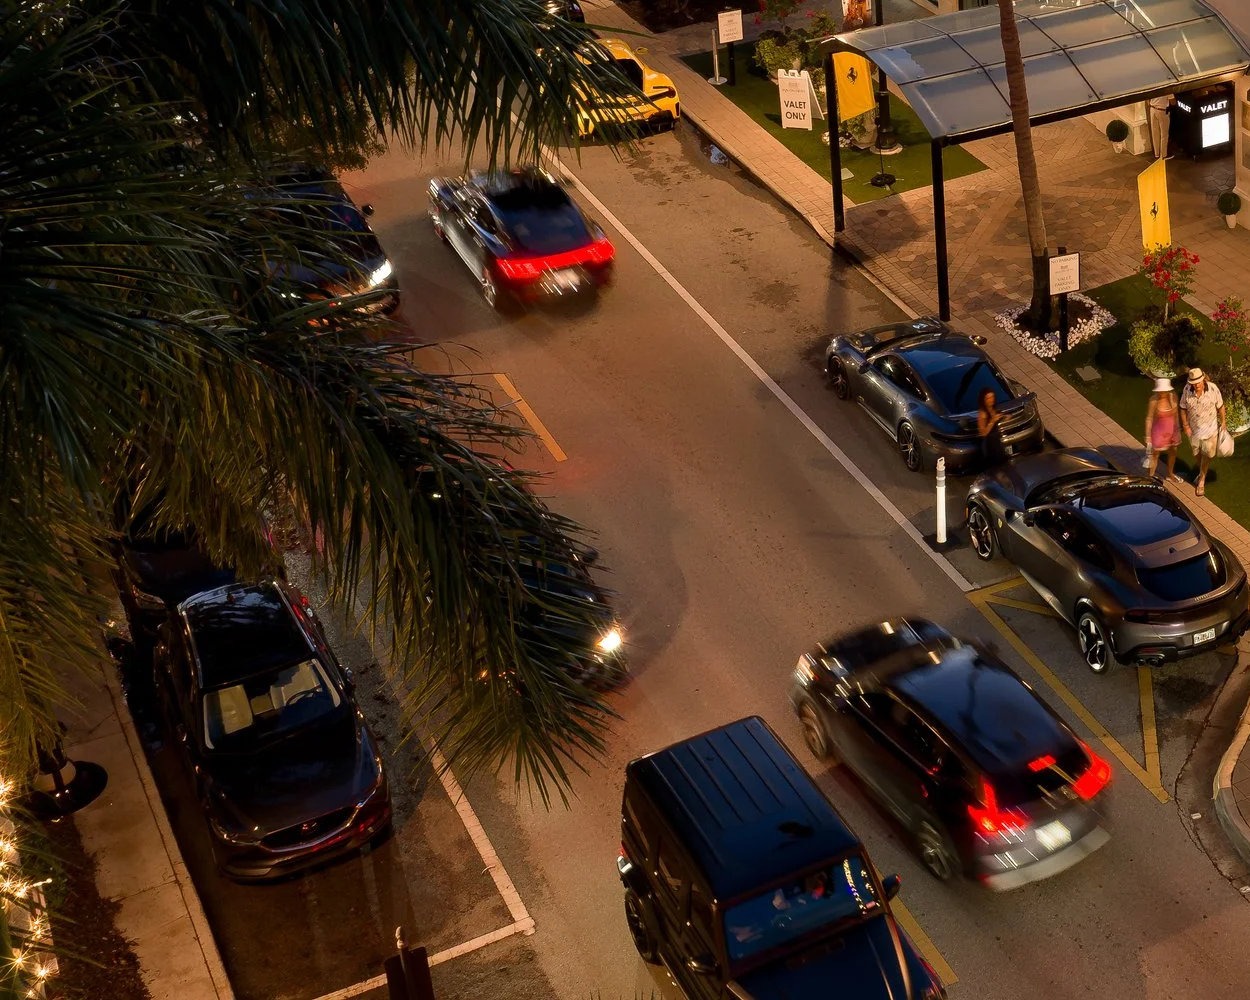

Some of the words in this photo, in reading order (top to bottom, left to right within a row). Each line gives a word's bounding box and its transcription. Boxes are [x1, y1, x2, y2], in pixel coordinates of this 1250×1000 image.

[783, 100, 807, 110] VALET
[1177, 100, 1192, 113] VALET
[1200, 99, 1228, 114] VALET
[785, 111, 807, 121] ONLY
